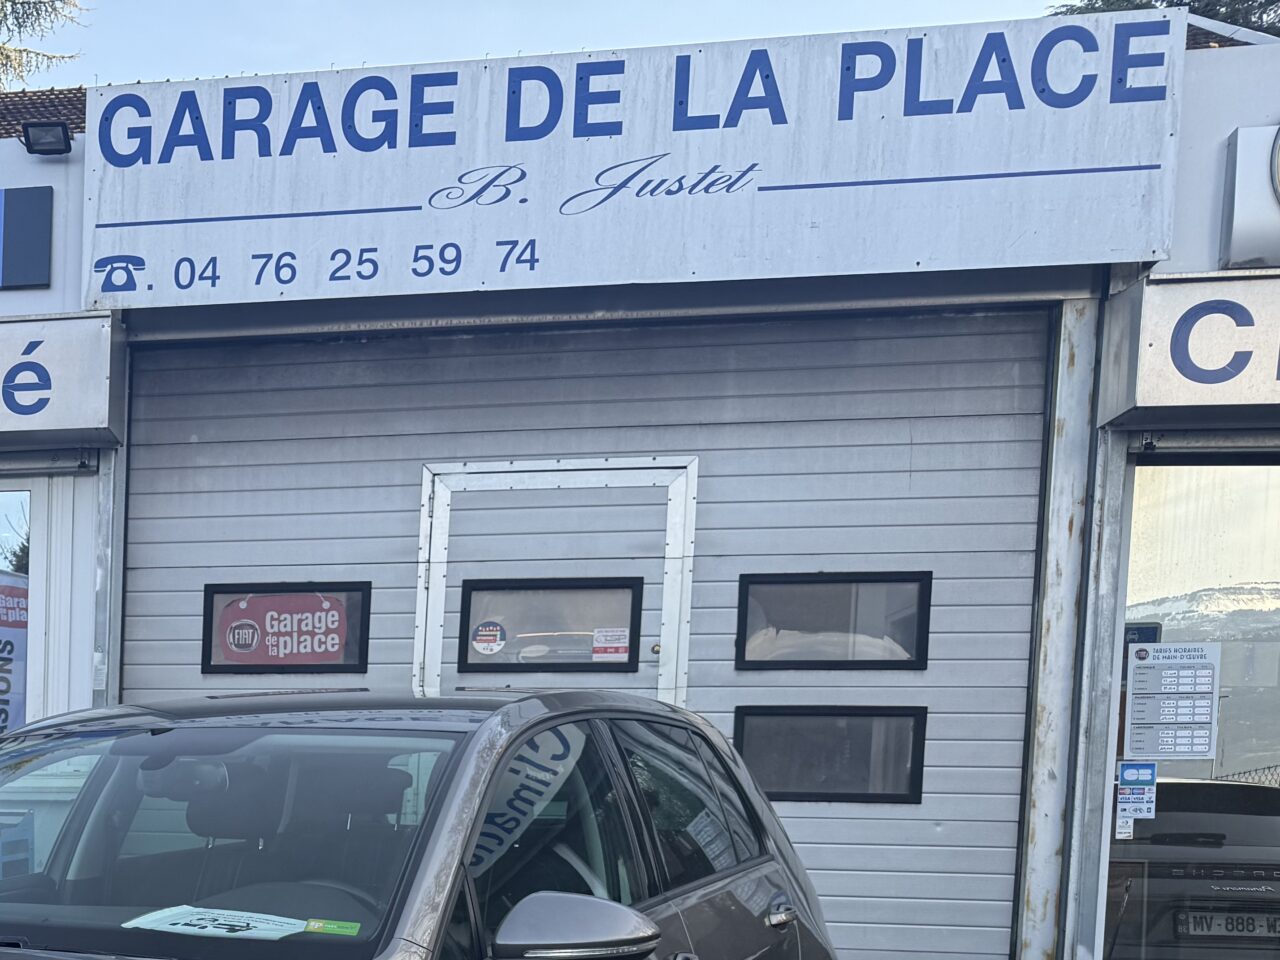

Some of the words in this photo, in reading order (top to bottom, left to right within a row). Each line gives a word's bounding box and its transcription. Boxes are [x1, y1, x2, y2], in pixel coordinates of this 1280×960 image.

[97, 71, 458, 168] GARAGE
[504, 59, 625, 143] DE
[672, 49, 788, 132] LA
[837, 19, 1171, 122] PLACE
[558, 152, 762, 216] Justet
[173, 256, 220, 290] 04
[250, 251, 298, 285] 76
[328, 247, 379, 281] 25
[411, 242, 463, 277] 59
[494, 238, 540, 273] 74
[1169, 299, 1280, 385] C
[7, 607, 28, 622] pla
[265, 610, 339, 633] Garage
[234, 629, 253, 644] FIAT
[265, 634, 277, 645] de
[278, 632, 340, 658] place
[268, 645, 277, 656] la
